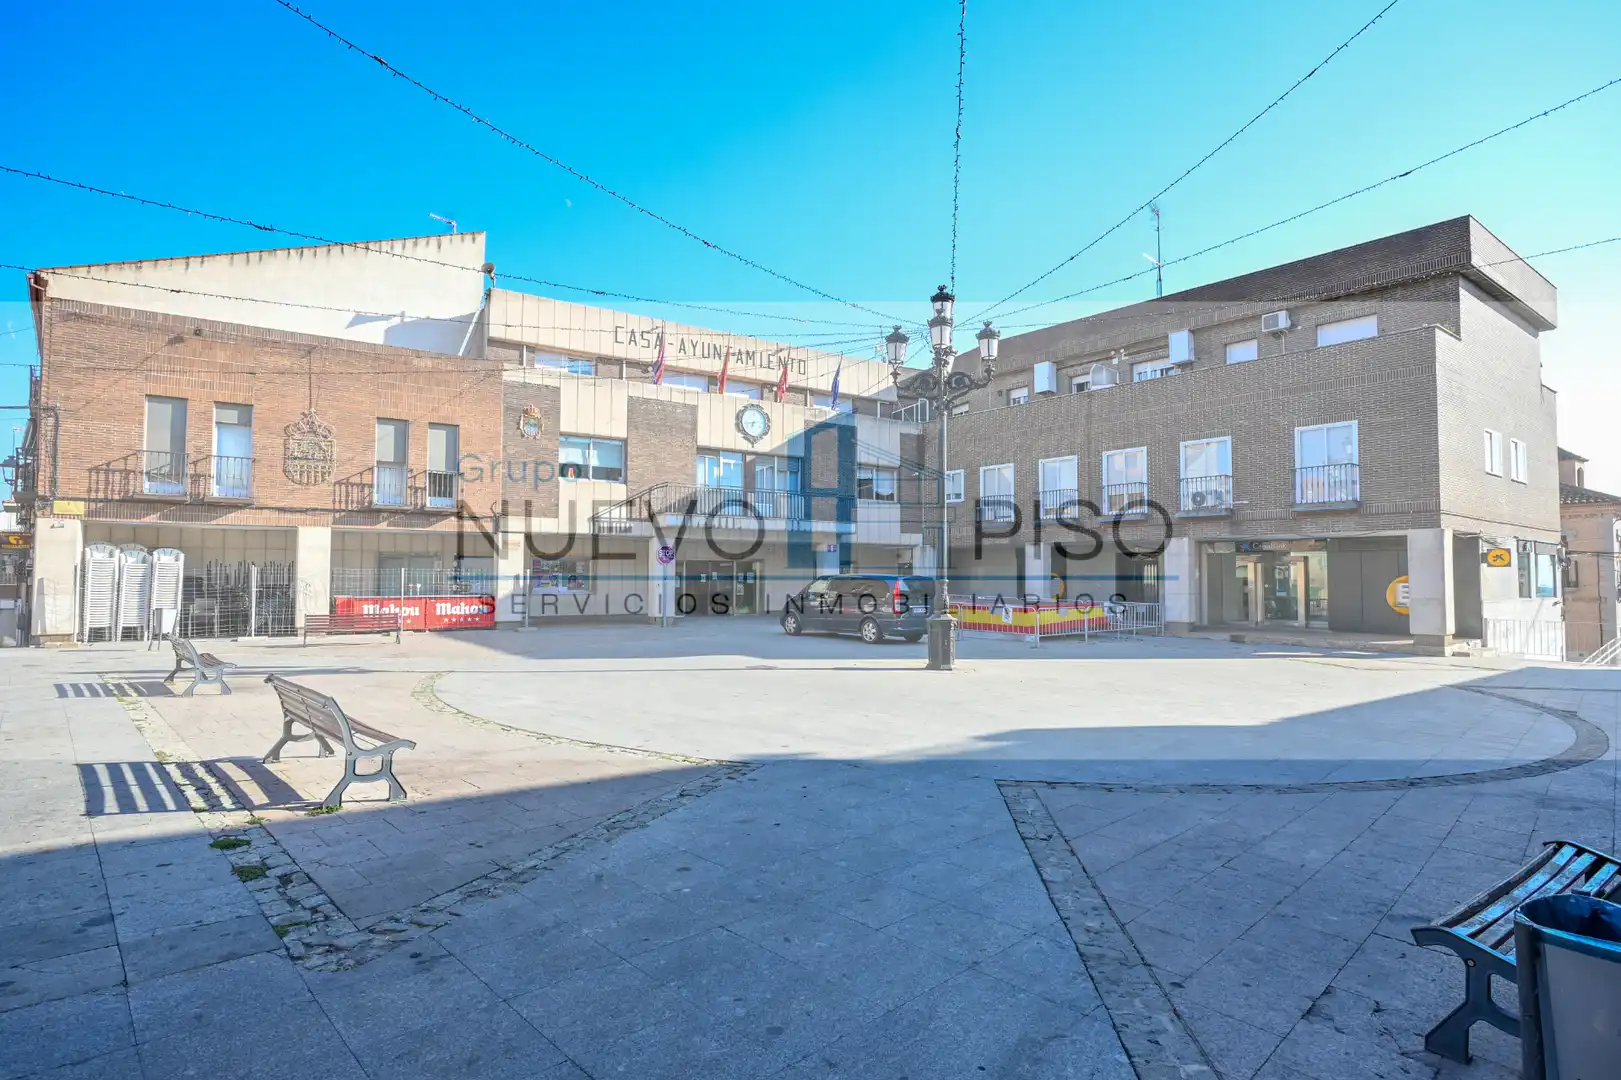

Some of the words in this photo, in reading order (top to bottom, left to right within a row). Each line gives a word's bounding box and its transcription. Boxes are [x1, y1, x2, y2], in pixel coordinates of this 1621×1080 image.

[658, 549, 674, 557] STOP
[362, 603, 420, 617] Mahou
[435, 602, 487, 616] Mahou
